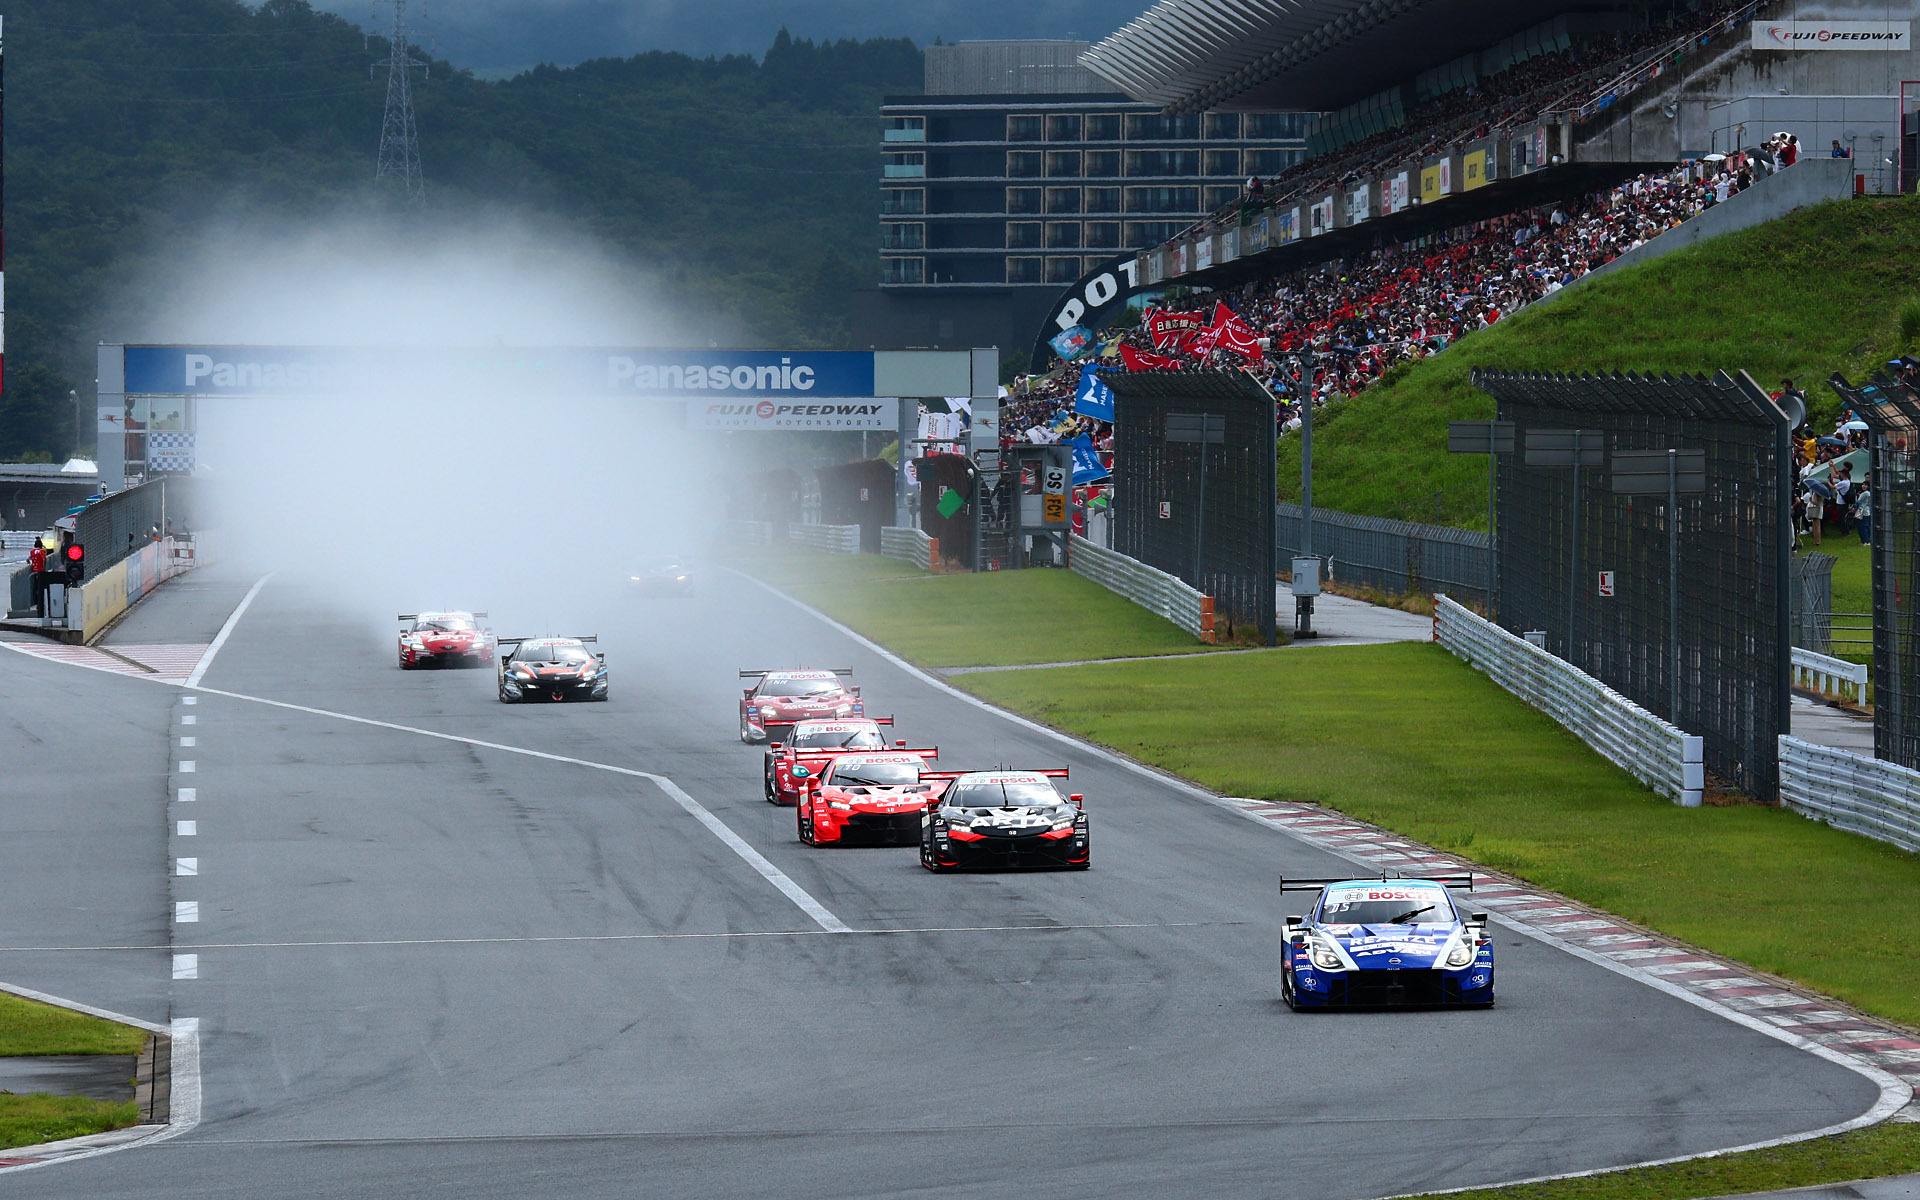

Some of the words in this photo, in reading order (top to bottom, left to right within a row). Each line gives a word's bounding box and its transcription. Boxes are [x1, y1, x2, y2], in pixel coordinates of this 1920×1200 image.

[1818, 31, 1904, 42] SPEEDWAY
[608, 355, 815, 391] Panasonic
[706, 404, 753, 416] FUJI
[756, 401, 883, 419] SPEEDWAY
[1046, 498, 1062, 518] FCY
[969, 815, 1054, 828] ARTA
[1368, 891, 1431, 900] BOSCH
[1350, 935, 1437, 947] REALIZE
